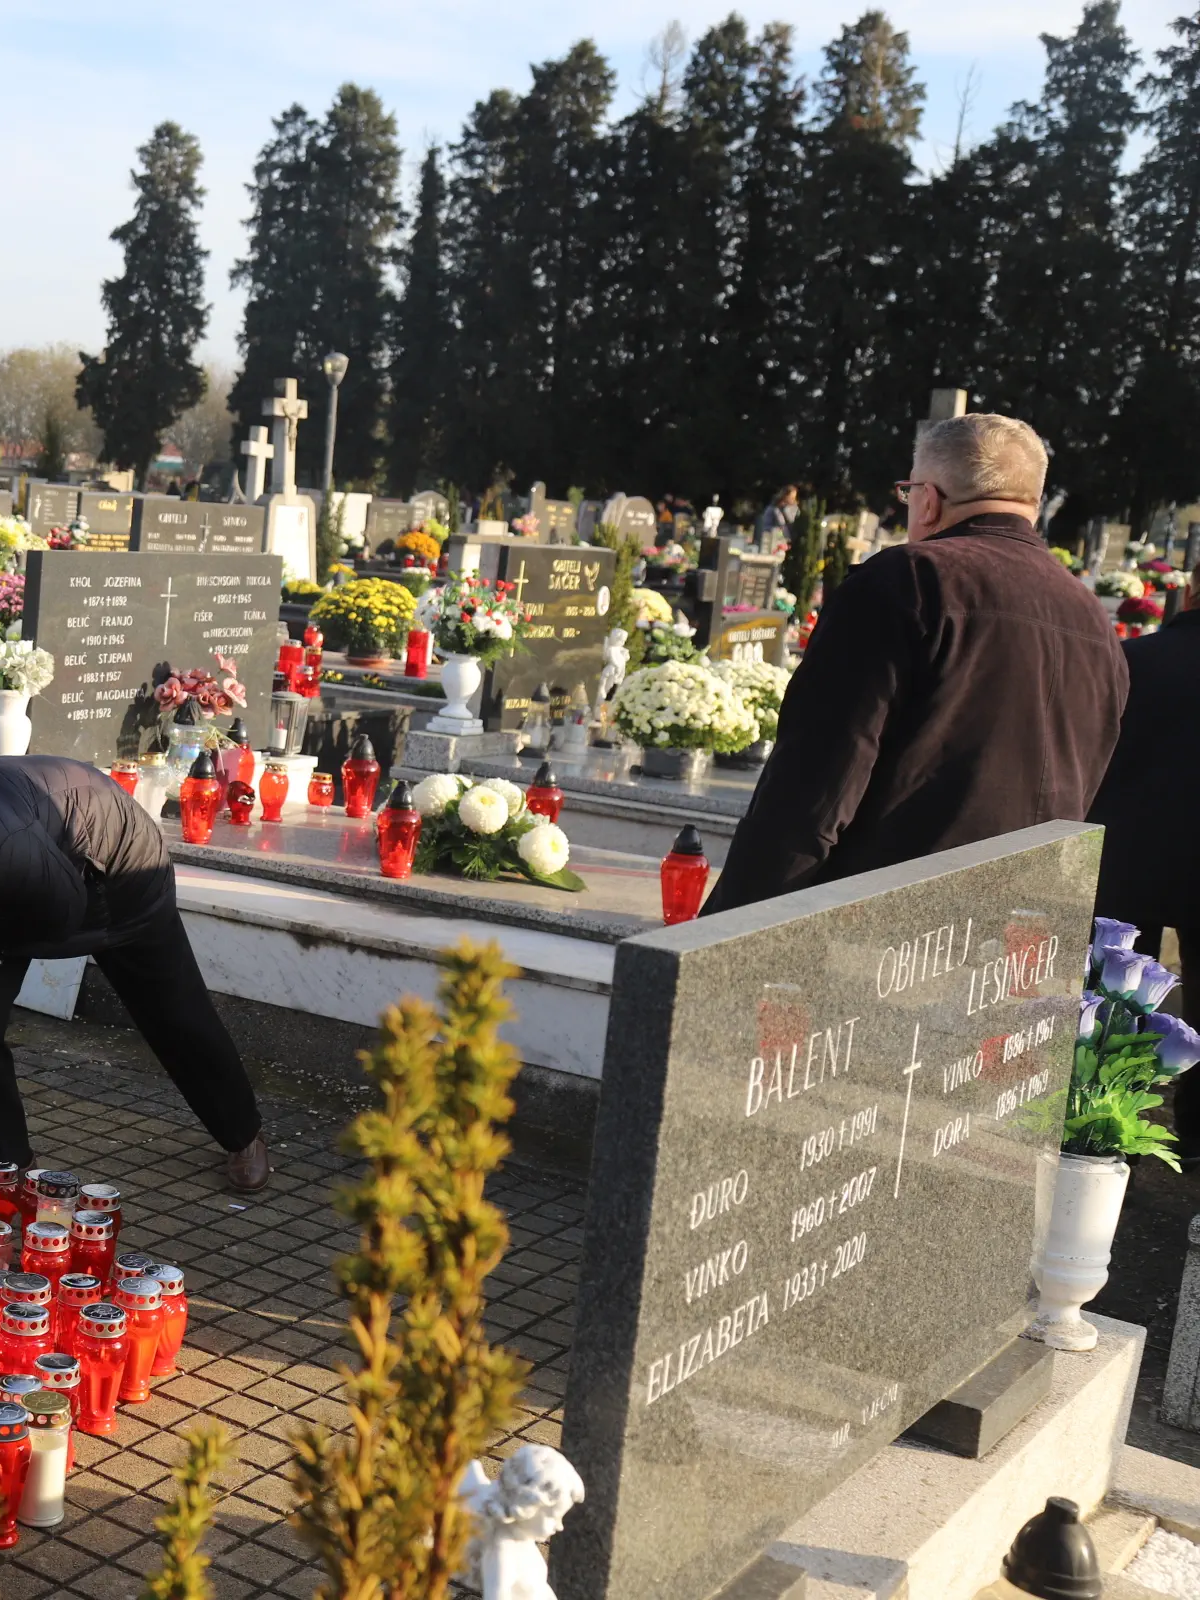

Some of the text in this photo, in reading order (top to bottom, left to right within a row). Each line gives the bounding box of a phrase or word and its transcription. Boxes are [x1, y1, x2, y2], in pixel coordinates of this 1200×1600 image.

[70, 577, 142, 588] KHOL JOZEFINA
[246, 576, 272, 586] NIKOLA
[67, 615, 133, 628] BELIĆ FRANJO
[64, 652, 133, 666] BELIĆ STJEPAN
[62, 688, 146, 704] BELIĆ MAGDALENA
[877, 917, 972, 998] OBITELJ
[967, 936, 1058, 1016] LESINGER
[746, 1017, 860, 1117] BALENT
[943, 1050, 983, 1094] VINKO
[933, 1112, 970, 1158] DORA
[690, 1104, 878, 1230] ĐURO 1930 1991
[685, 1167, 876, 1304] VINKO 1960 2007
[646, 1232, 866, 1406] ELIZABETA 1933 2020
